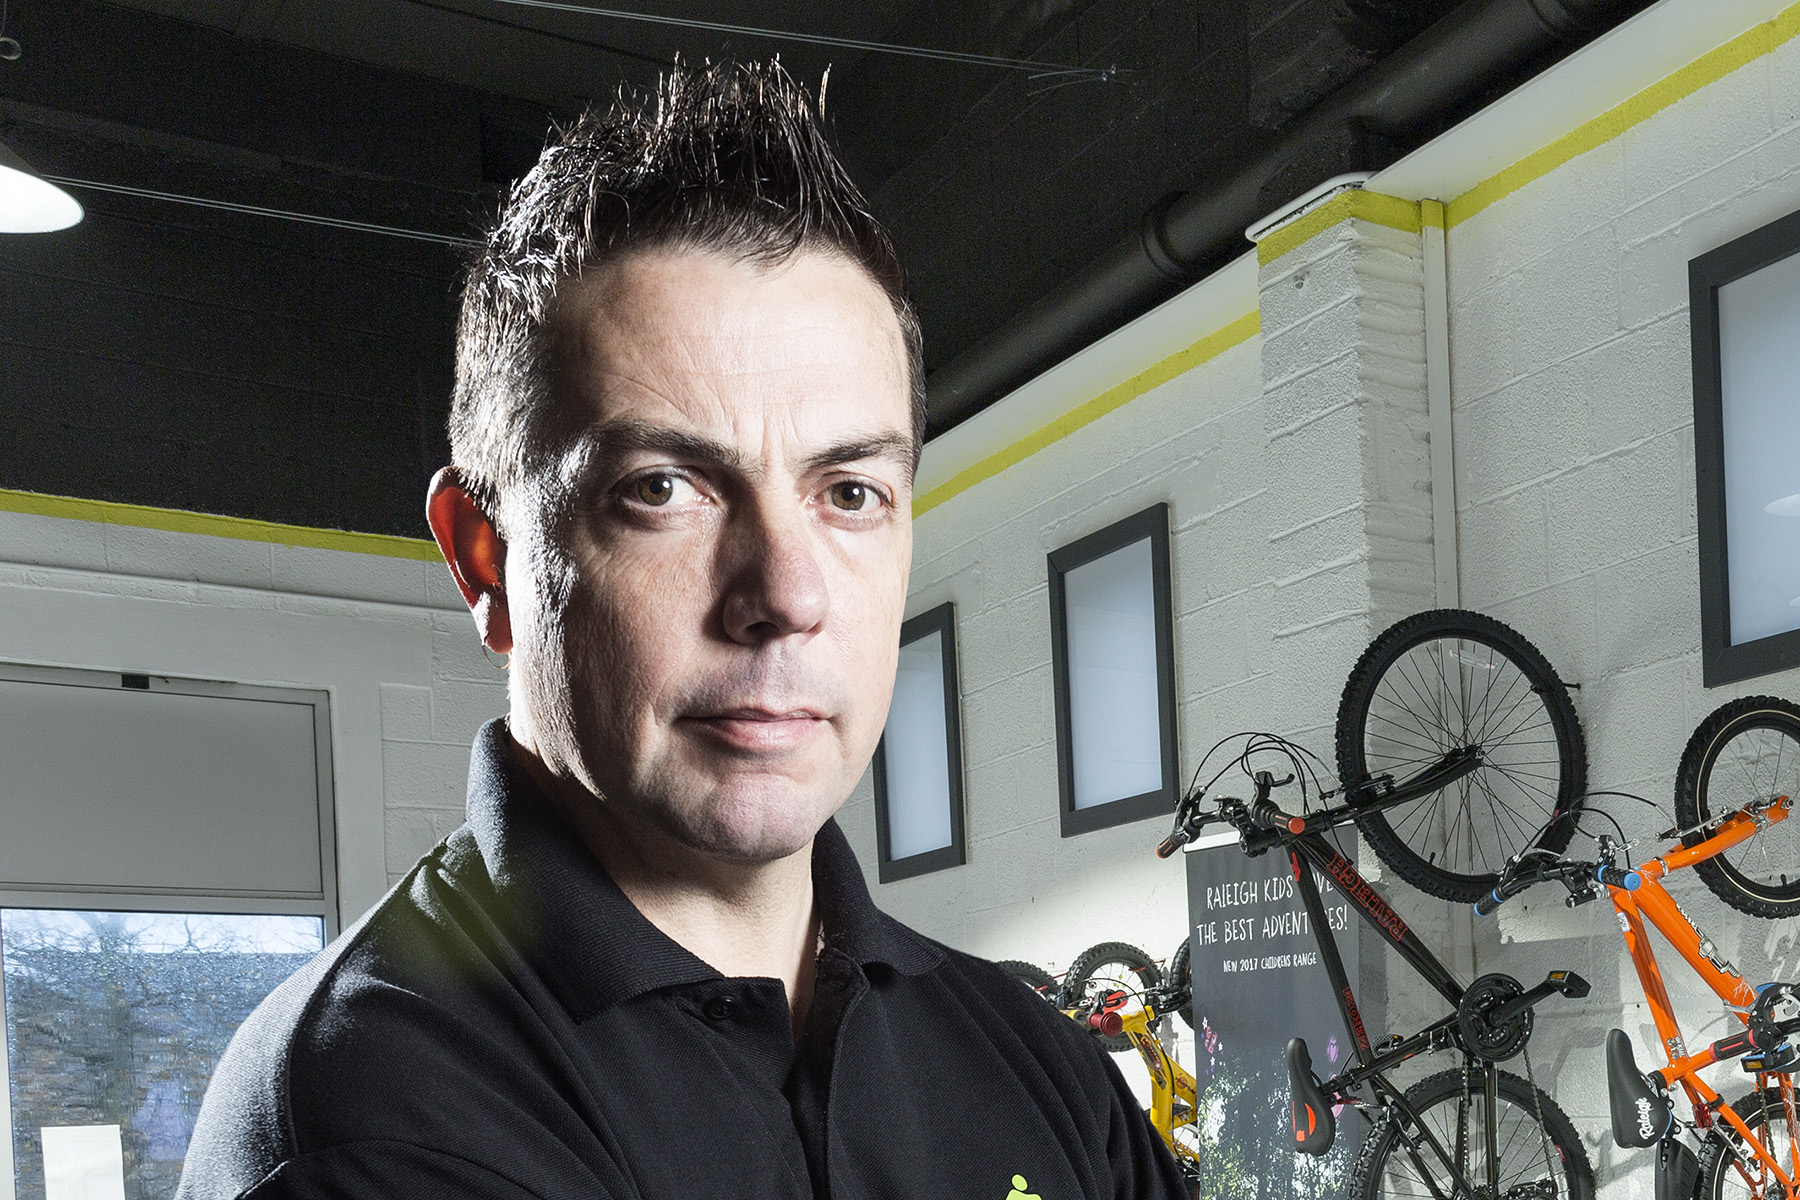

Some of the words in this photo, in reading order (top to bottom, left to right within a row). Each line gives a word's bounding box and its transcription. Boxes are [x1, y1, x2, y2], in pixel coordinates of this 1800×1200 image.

[1206, 881, 1258, 910] RALEIGH
[1264, 874, 1294, 903] KIDS
[1325, 853, 1408, 942] RALEIGH
[1197, 921, 1218, 946] THE
[1224, 917, 1254, 944] BEST
[1262, 904, 1348, 939] ADVENTES!
[1223, 960, 1238, 973] NEW
[1240, 958, 1258, 972] 2017
[1260, 954, 1292, 970] CHILDRENS
[1293, 952, 1317, 968] RANGE
[1635, 1097, 1655, 1140] Raleigh
